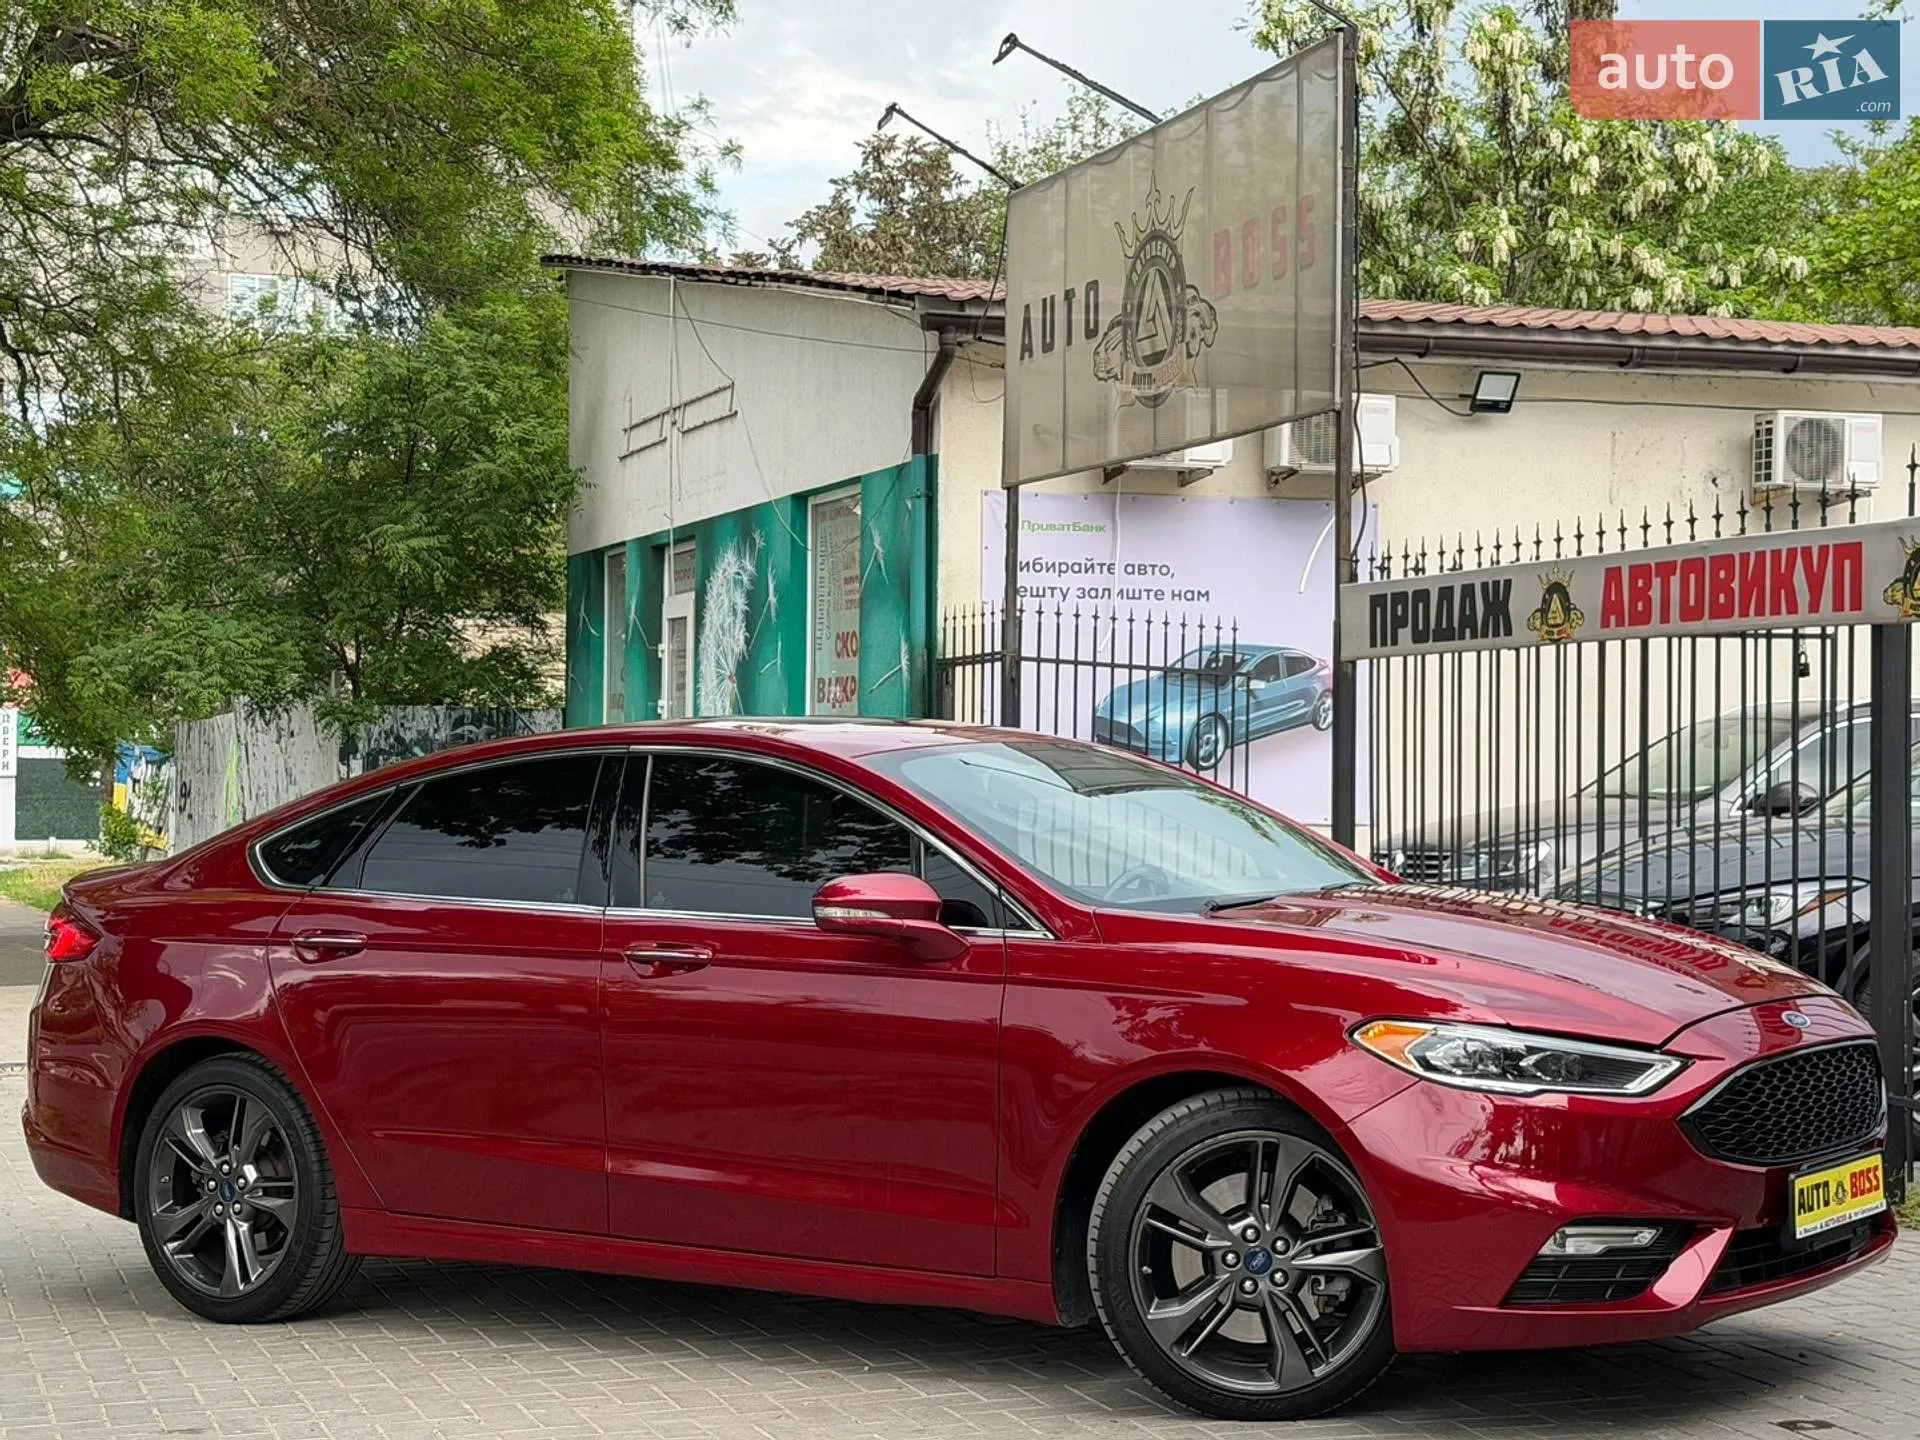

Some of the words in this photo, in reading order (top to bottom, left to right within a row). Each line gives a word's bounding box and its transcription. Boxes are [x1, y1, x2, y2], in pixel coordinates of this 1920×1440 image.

[1019, 279, 1099, 361] AUTO
[1212, 194, 1316, 299] BOSS
[1021, 520, 1107, 534] ПриватБанк
[1019, 557, 1115, 578] ибирайте
[1124, 563, 1175, 579] авто,
[1017, 585, 1071, 602] ешту
[1076, 586, 1165, 601] залиште
[1171, 588, 1210, 602] нам
[1369, 579, 1513, 649] ПРОДАЖ
[1600, 541, 1864, 630] АВТОВИКУП
[1798, 1181, 1830, 1216] AUTO
[1850, 1165, 1880, 1199] BOSS
